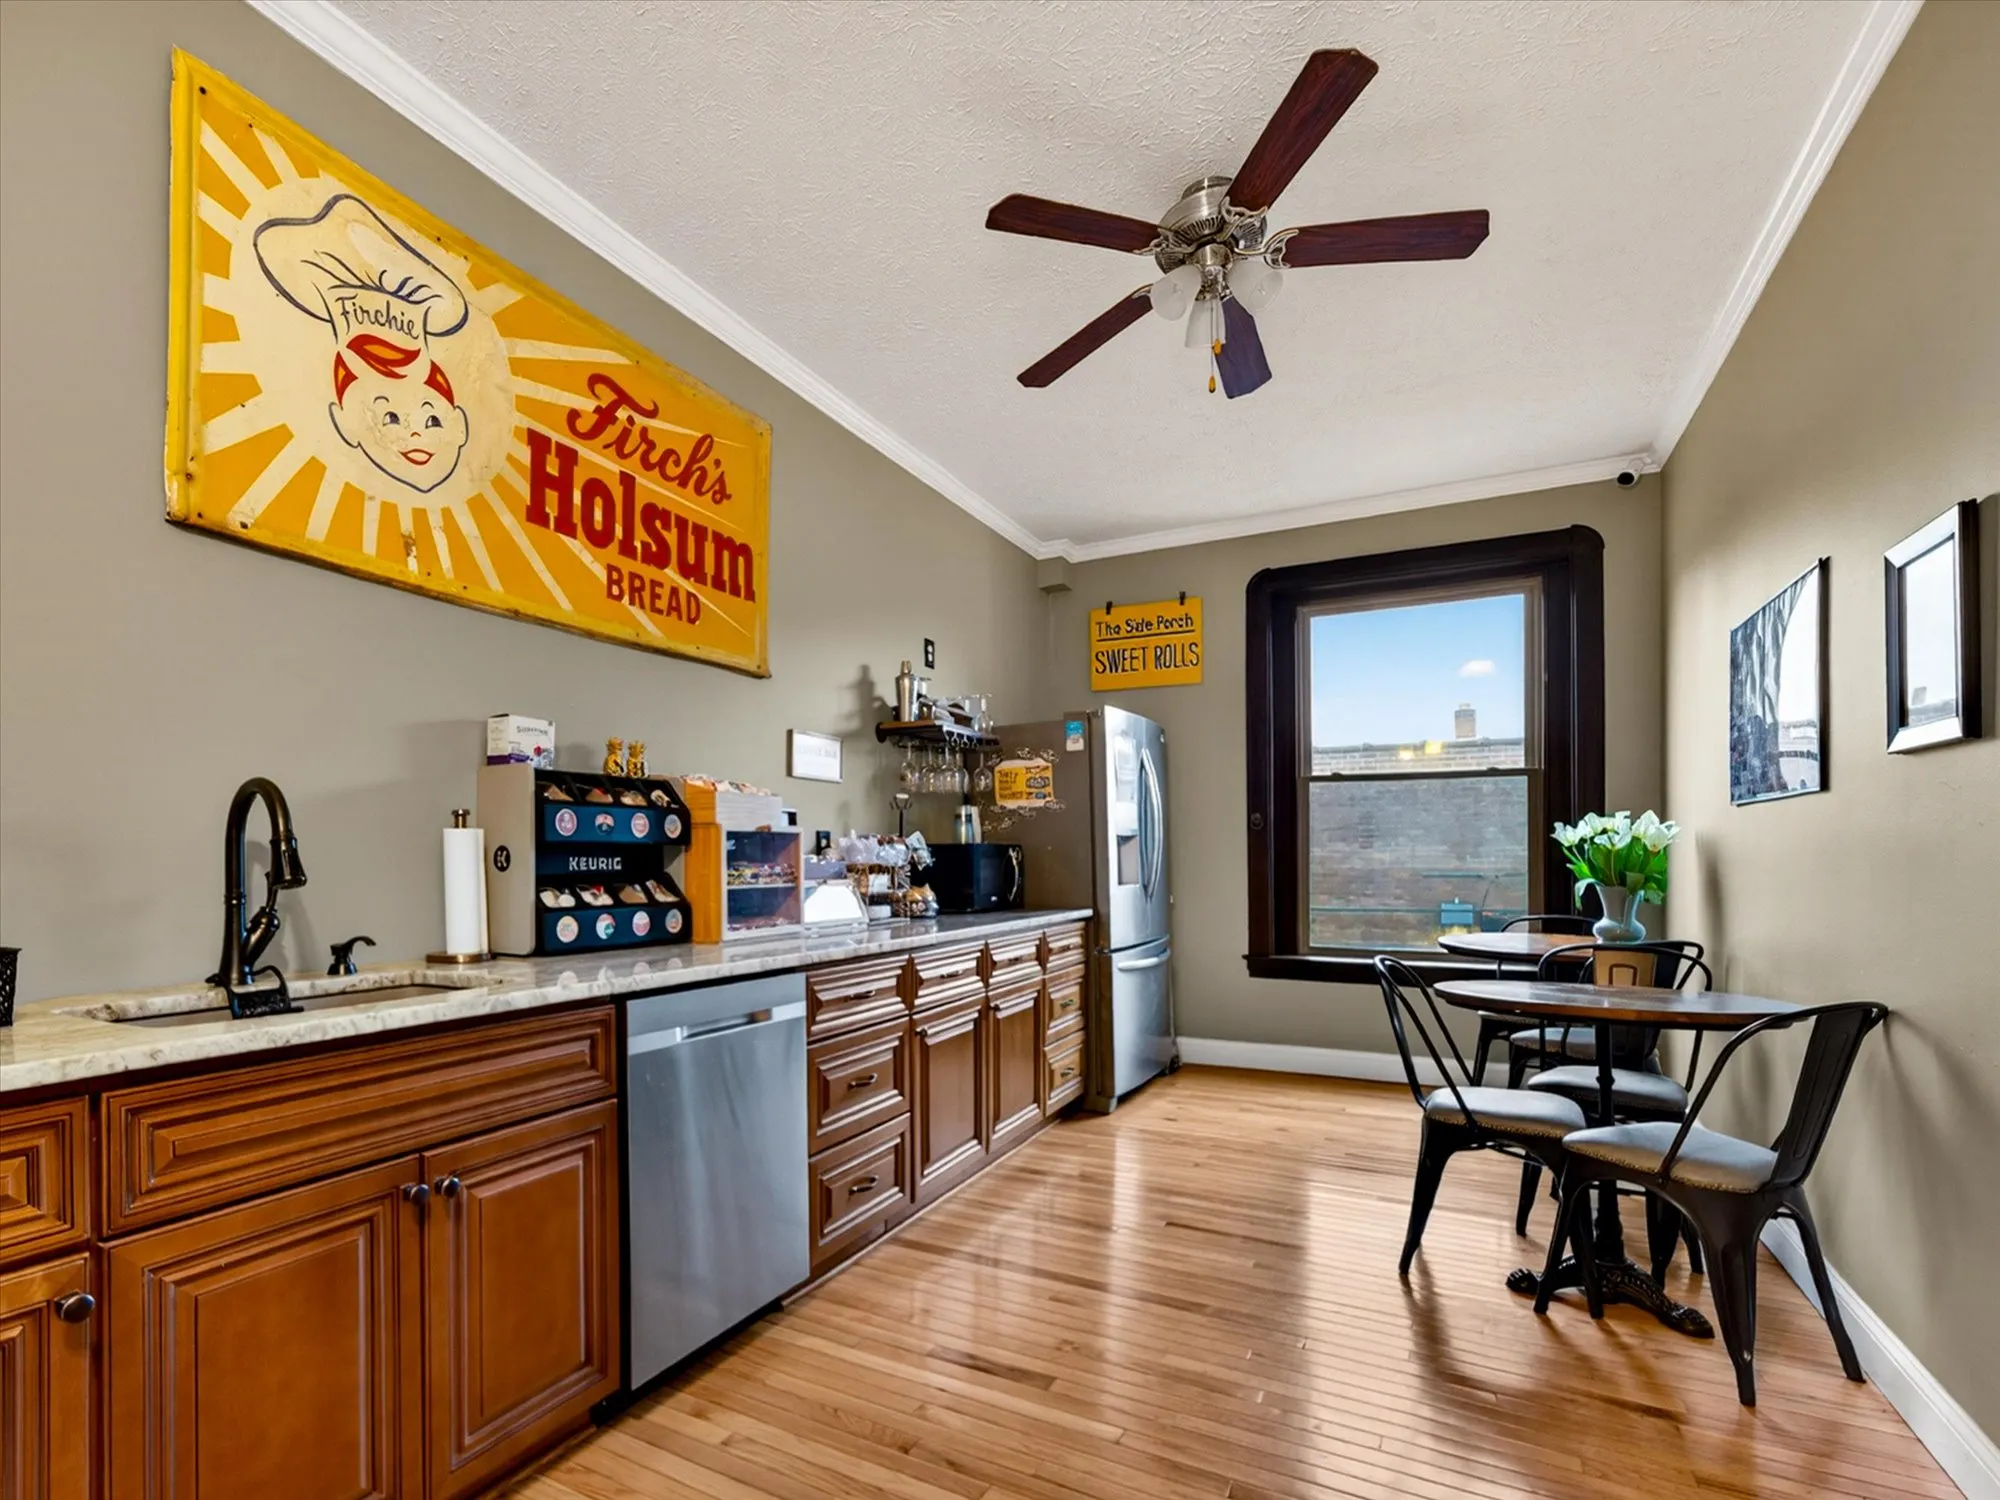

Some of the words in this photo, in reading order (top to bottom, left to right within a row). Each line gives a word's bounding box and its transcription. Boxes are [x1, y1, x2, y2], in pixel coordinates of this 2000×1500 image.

[335, 293, 419, 340] Firchie
[566, 372, 732, 505] Firch's
[525, 427, 756, 603] Holsum
[606, 563, 701, 625] BREAD
[1095, 621, 1121, 638] The
[1125, 618, 1154, 634] Side
[1156, 613, 1194, 630] Porch
[1095, 647, 1149, 674] SWEET
[1154, 642, 1200, 670] ROLLS
[568, 856, 622, 871] KEURIG
